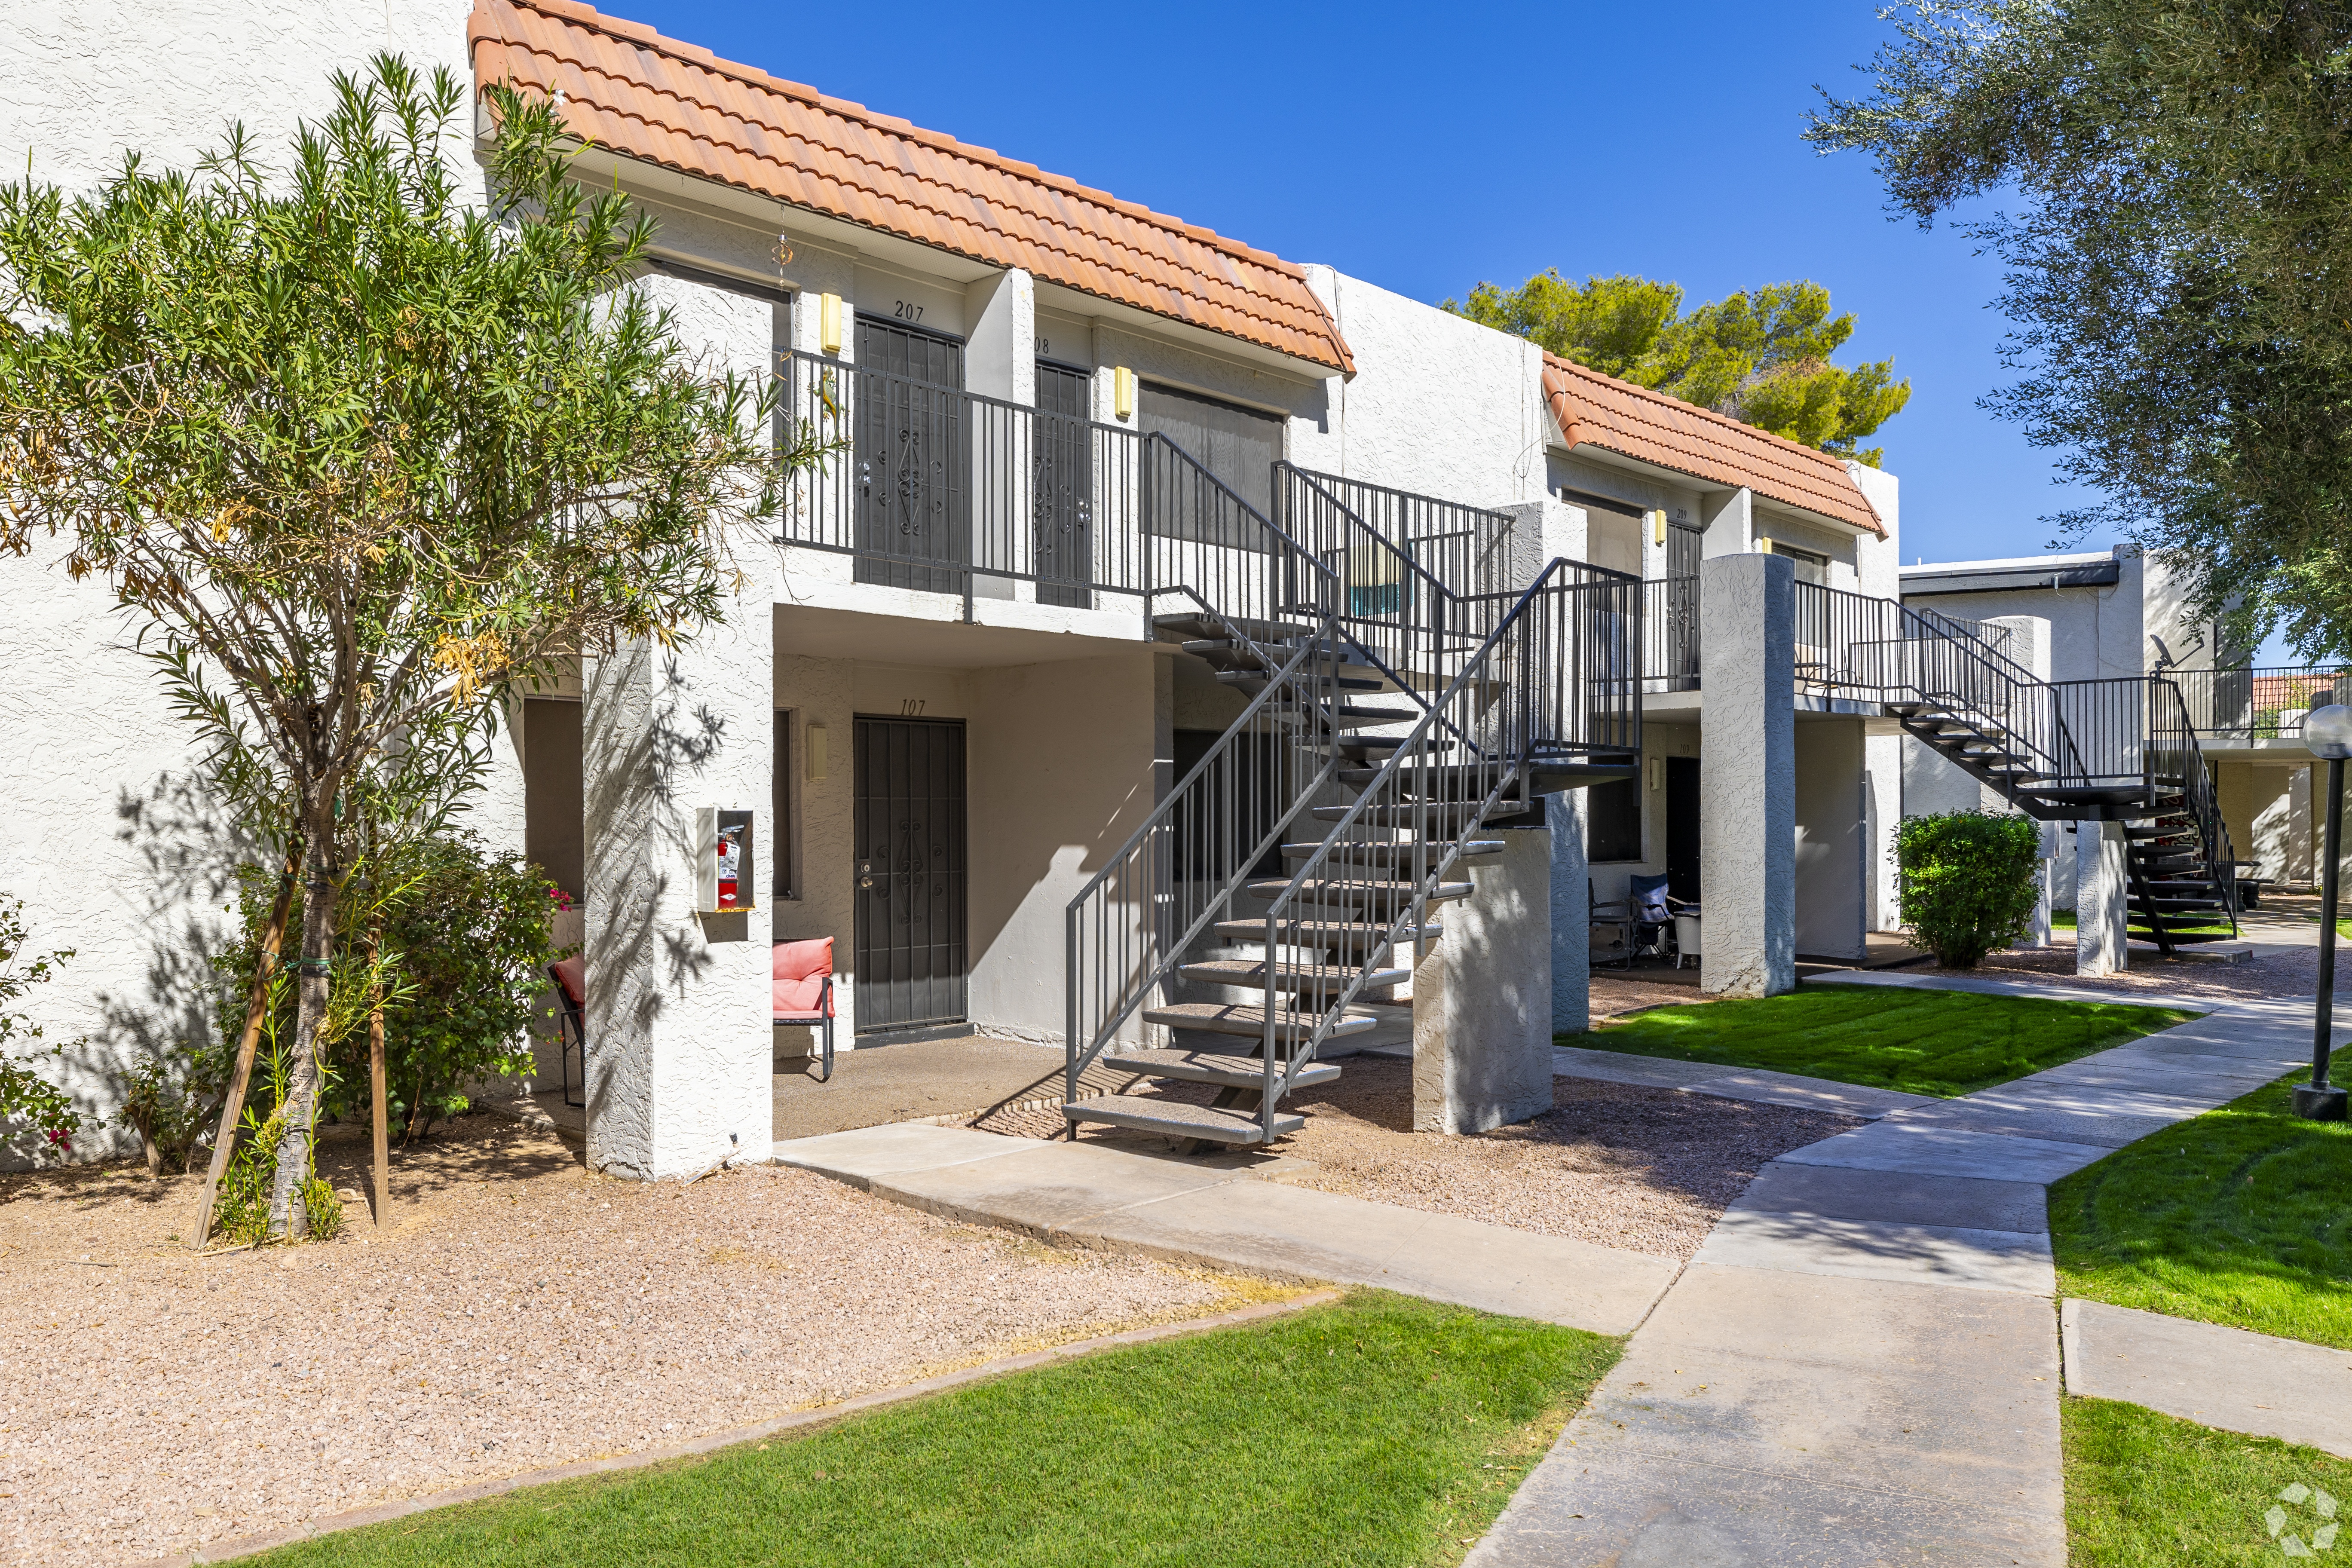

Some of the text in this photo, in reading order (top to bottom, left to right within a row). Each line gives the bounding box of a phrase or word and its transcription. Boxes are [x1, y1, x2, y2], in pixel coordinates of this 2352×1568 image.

[895, 300, 923, 322] 207
[1035, 337, 1049, 354] 08
[1677, 508, 1687, 520] 209
[901, 698, 925, 717] 107
[1680, 744, 1690, 754] 109
